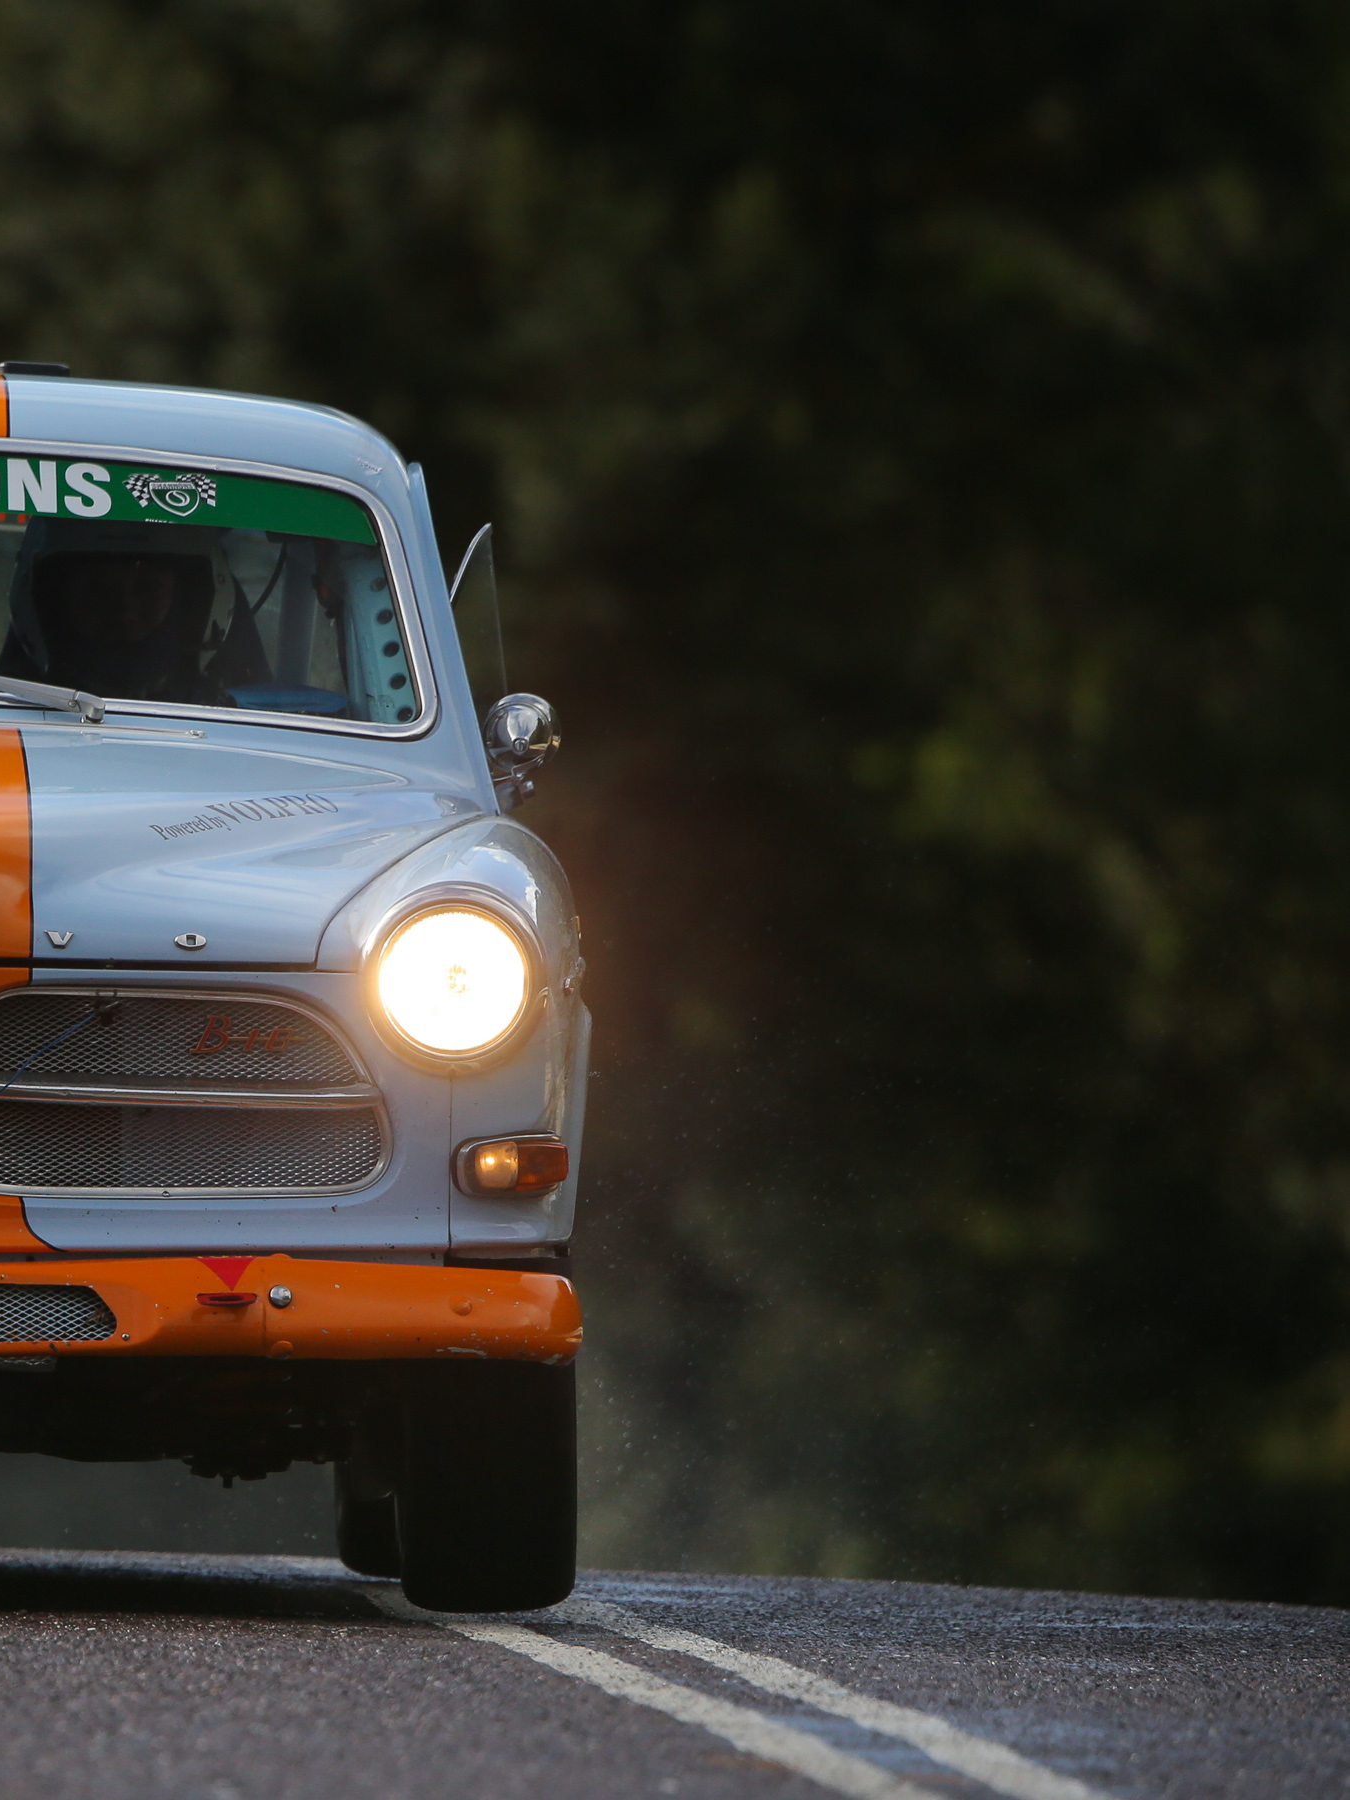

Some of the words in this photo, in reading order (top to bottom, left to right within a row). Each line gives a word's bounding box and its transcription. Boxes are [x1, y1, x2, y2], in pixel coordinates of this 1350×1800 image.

[205, 793, 338, 825] VOLPRO
[207, 814, 232, 831] by
[148, 814, 211, 841] Powered
